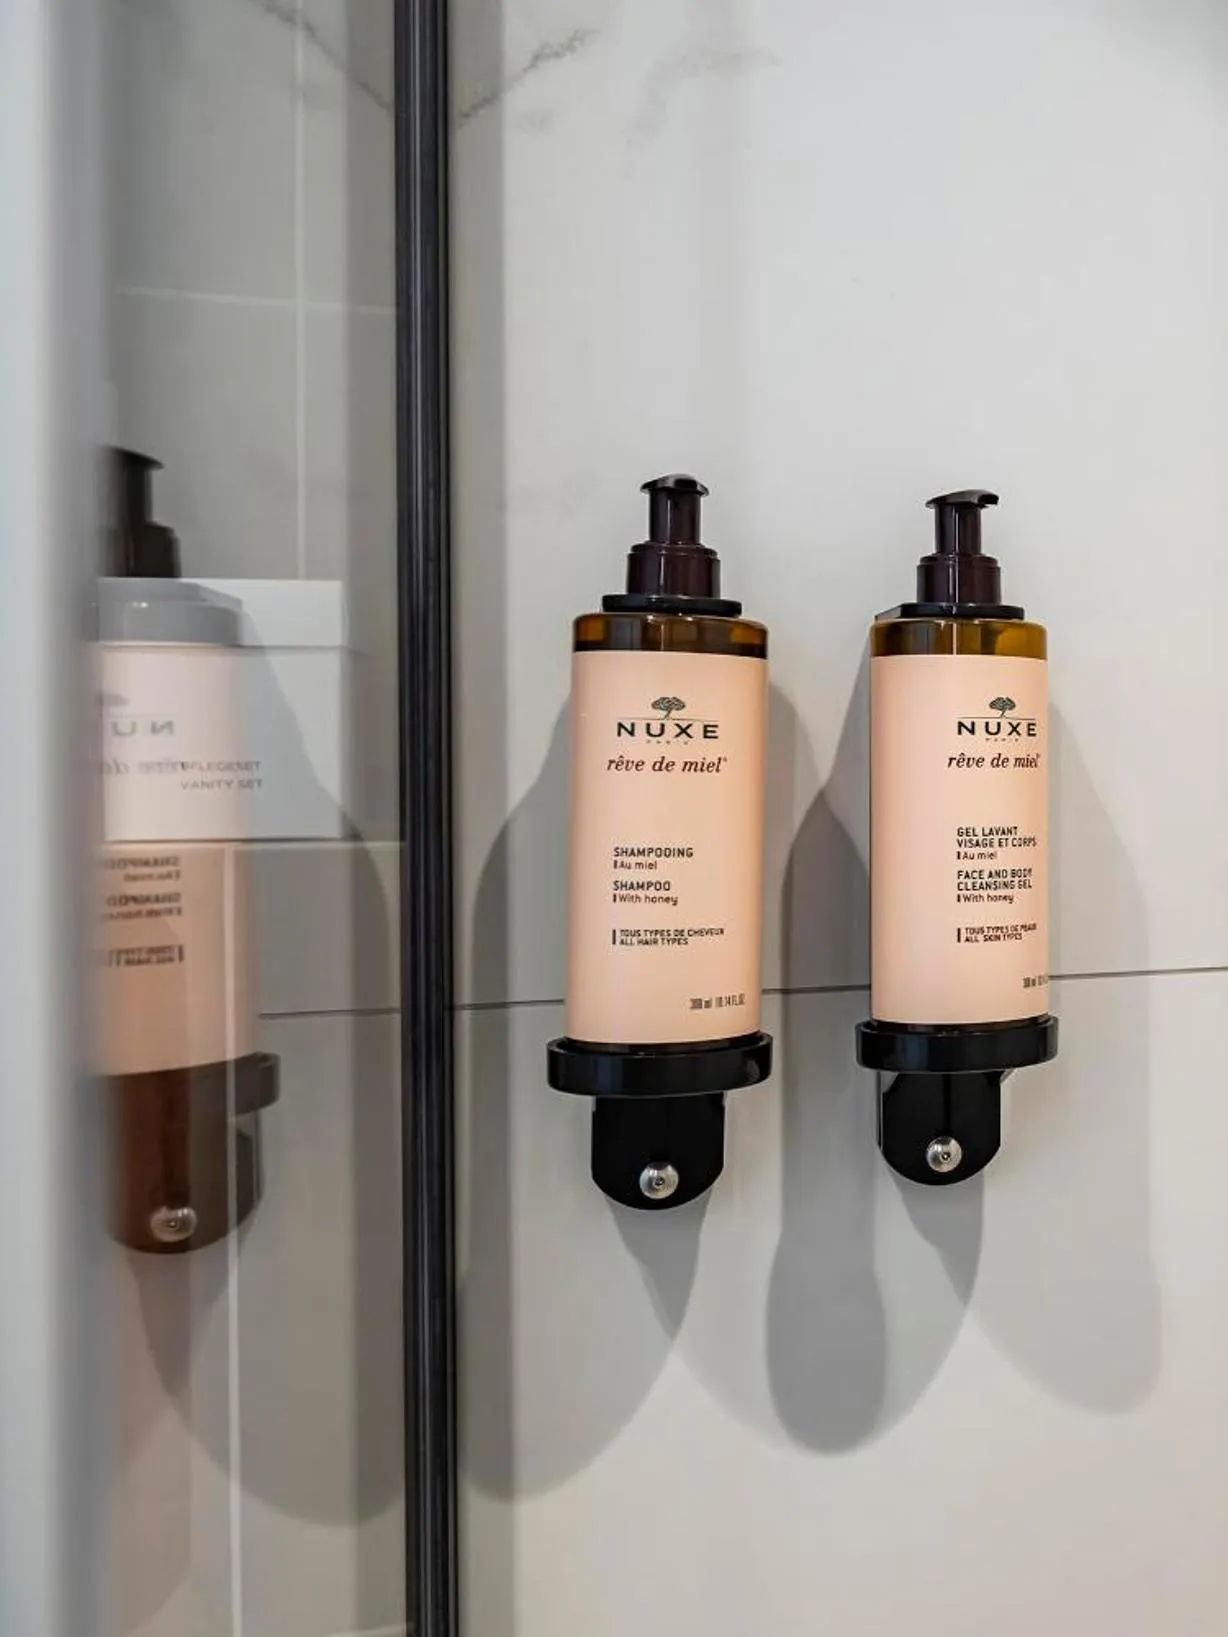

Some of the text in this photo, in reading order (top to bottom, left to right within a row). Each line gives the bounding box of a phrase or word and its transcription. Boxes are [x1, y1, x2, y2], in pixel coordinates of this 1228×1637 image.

[616, 721, 719, 739] NUXE
[957, 720, 1037, 737] NUXE
[607, 755, 645, 772] rêve
[651, 756, 676, 772] de
[947, 752, 985, 769] rêve
[990, 753, 1010, 769] de
[180, 778, 263, 791] VANITY SET
[956, 826, 1018, 837] GEL LAVANT
[956, 837, 1037, 848] VISAGE ET CORPS
[613, 846, 694, 858] SHAMPOOING
[962, 851, 997, 860] Au miel
[618, 860, 658, 870] Au miel
[957, 868, 1032, 880] FACE AND BODY
[612, 879, 671, 891] SHAMPOO
[957, 879, 1032, 891] CLEANSING GEL
[618, 893, 679, 906] With honey
[962, 893, 1014, 904] With honey
[620, 929, 641, 938] TOUS
[643, 929, 671, 938] TYPES
[965, 926, 985, 935] TOUS
[986, 925, 1009, 935] TYPES
[619, 937, 689, 947] ALL HAIR TYPES
[964, 934, 979, 943] ALL
